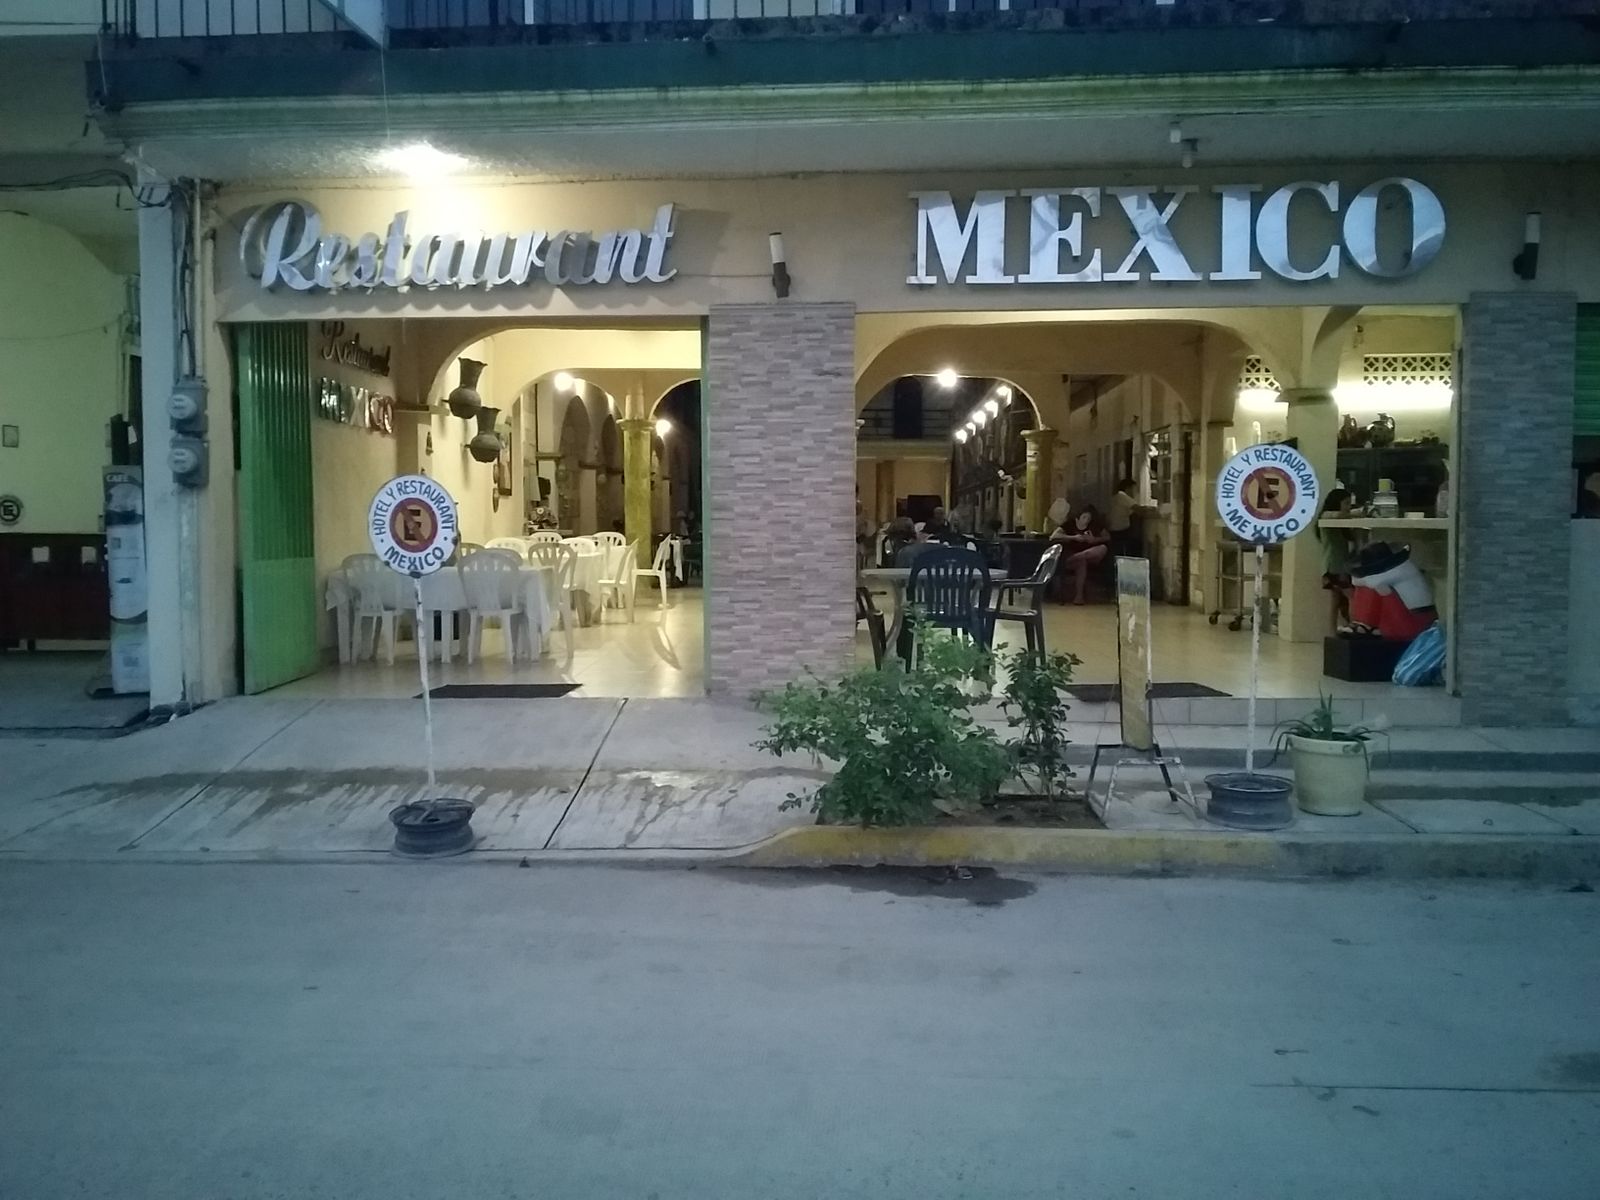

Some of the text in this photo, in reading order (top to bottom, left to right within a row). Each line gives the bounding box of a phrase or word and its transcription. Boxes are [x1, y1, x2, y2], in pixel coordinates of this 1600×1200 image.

[240, 202, 678, 290] Restaurant
[906, 177, 1446, 285] MEXICO
[1221, 447, 1316, 499] HOTEL Y RESTAURANT
[372, 480, 455, 536] HOTEL Y RESTAURANT
[1226, 508, 1300, 540] MEXICO
[384, 545, 445, 571] MEXICO
